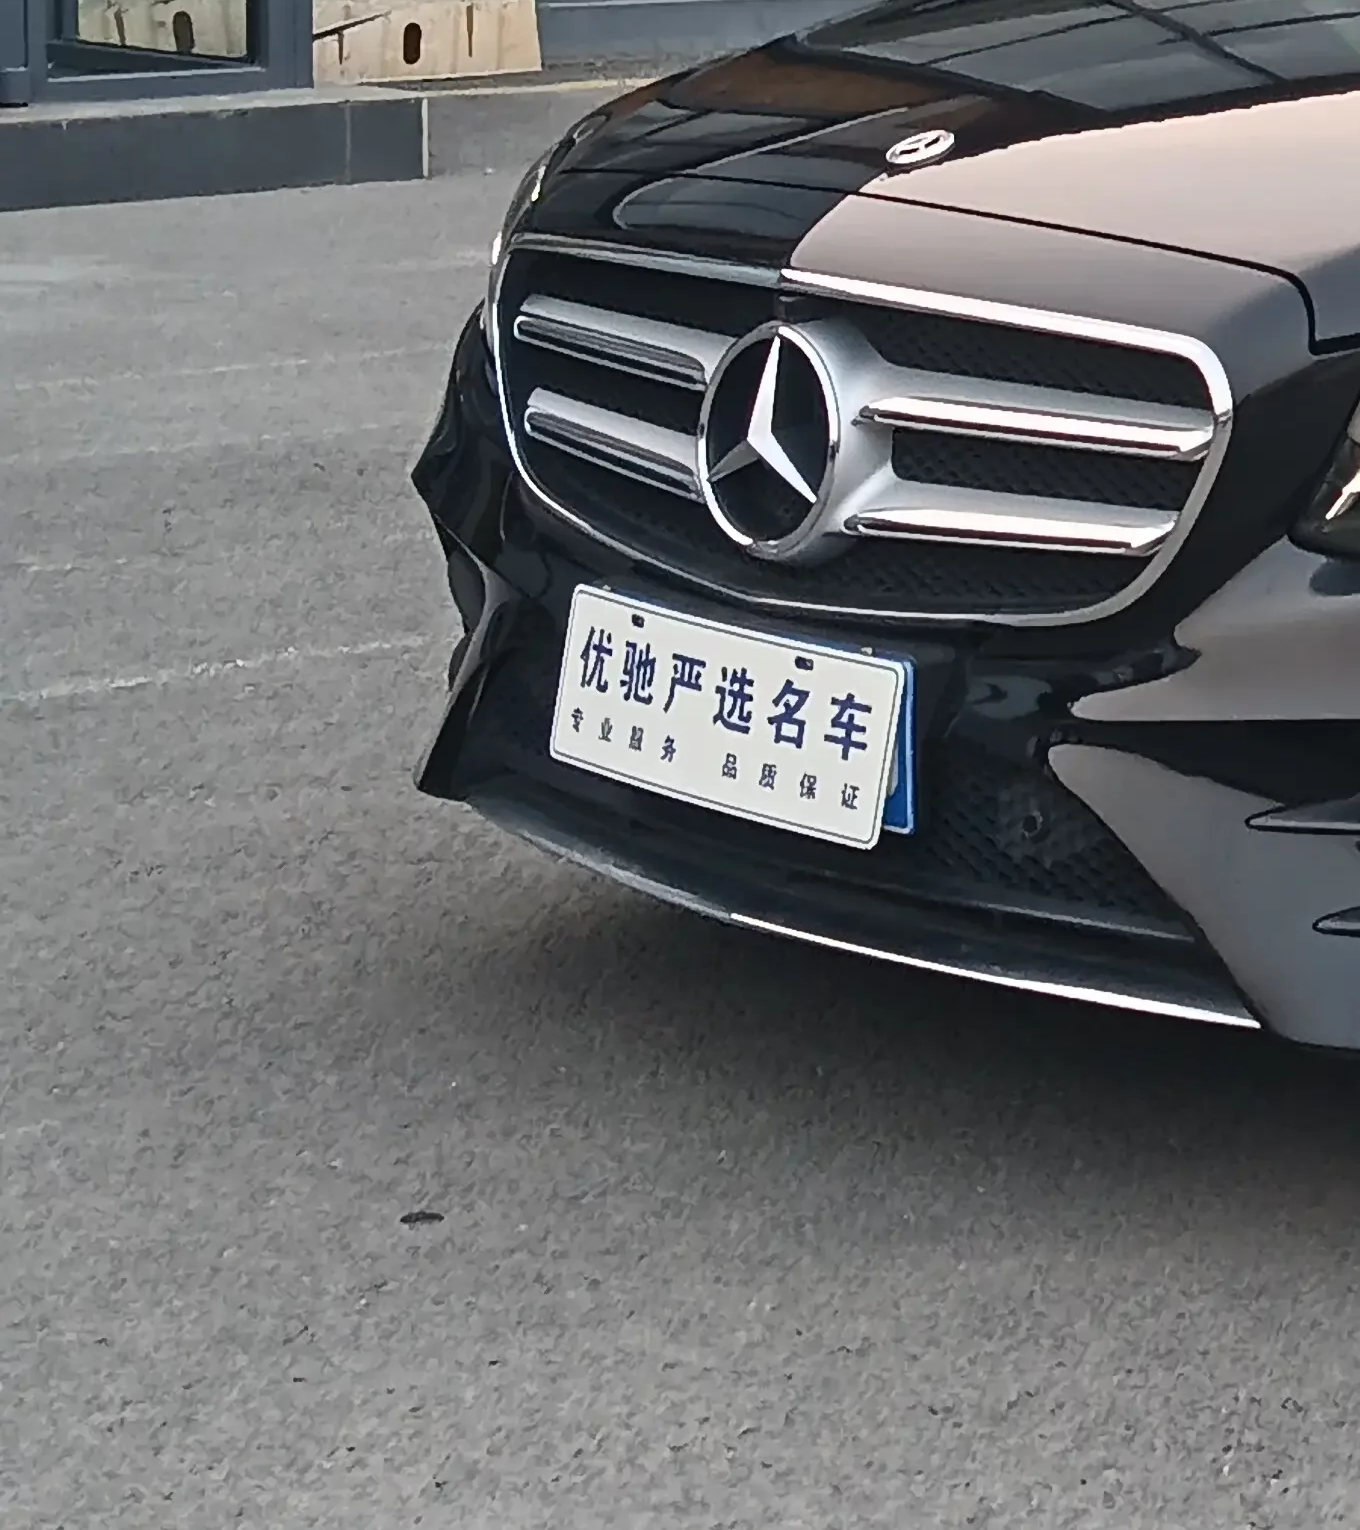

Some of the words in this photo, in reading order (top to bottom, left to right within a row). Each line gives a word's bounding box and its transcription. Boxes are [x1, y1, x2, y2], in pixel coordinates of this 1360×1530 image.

[580, 626, 872, 761] 优驰严选名车
[722, 753, 860, 810] 品质保证
